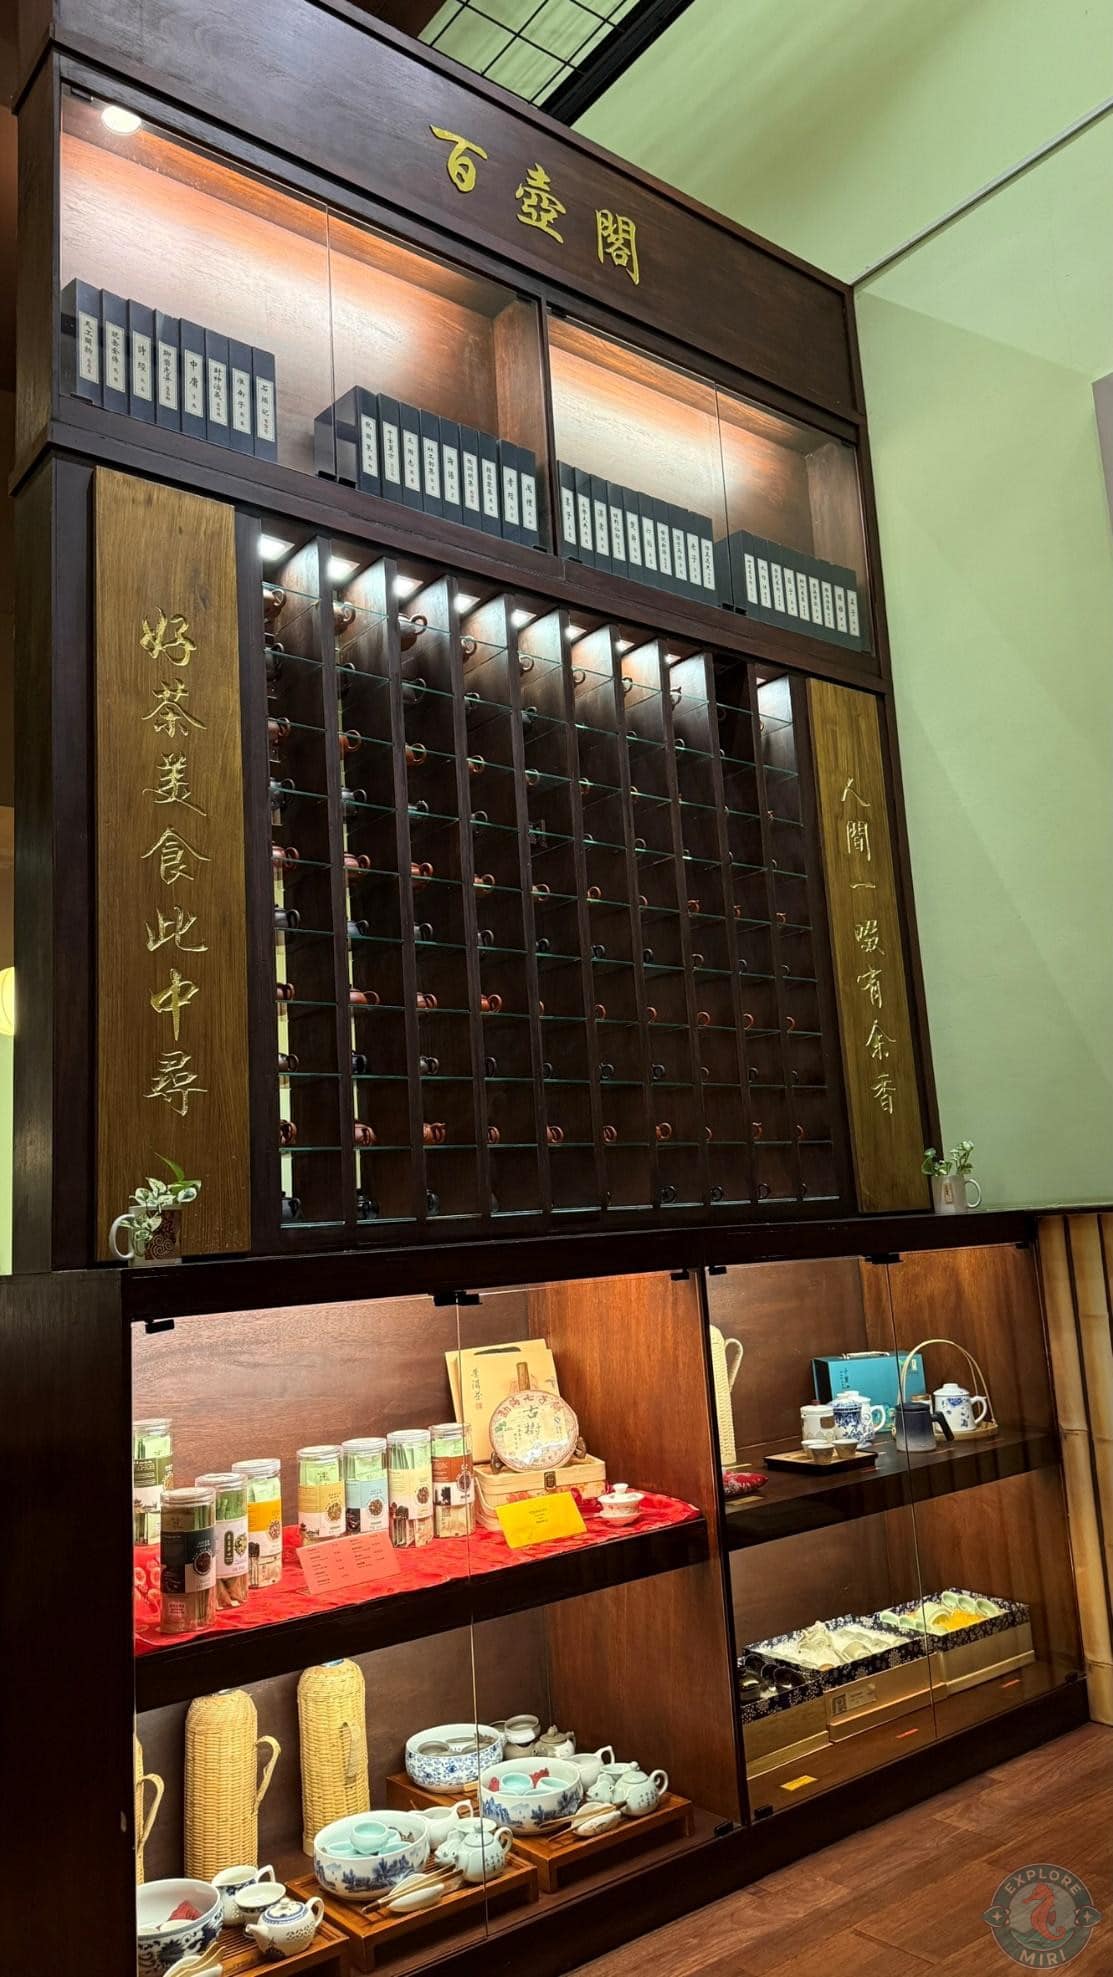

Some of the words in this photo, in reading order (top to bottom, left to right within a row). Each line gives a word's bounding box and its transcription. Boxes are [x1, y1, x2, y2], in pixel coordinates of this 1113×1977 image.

[140, 606, 212, 1117] 好茶美食此中尋
